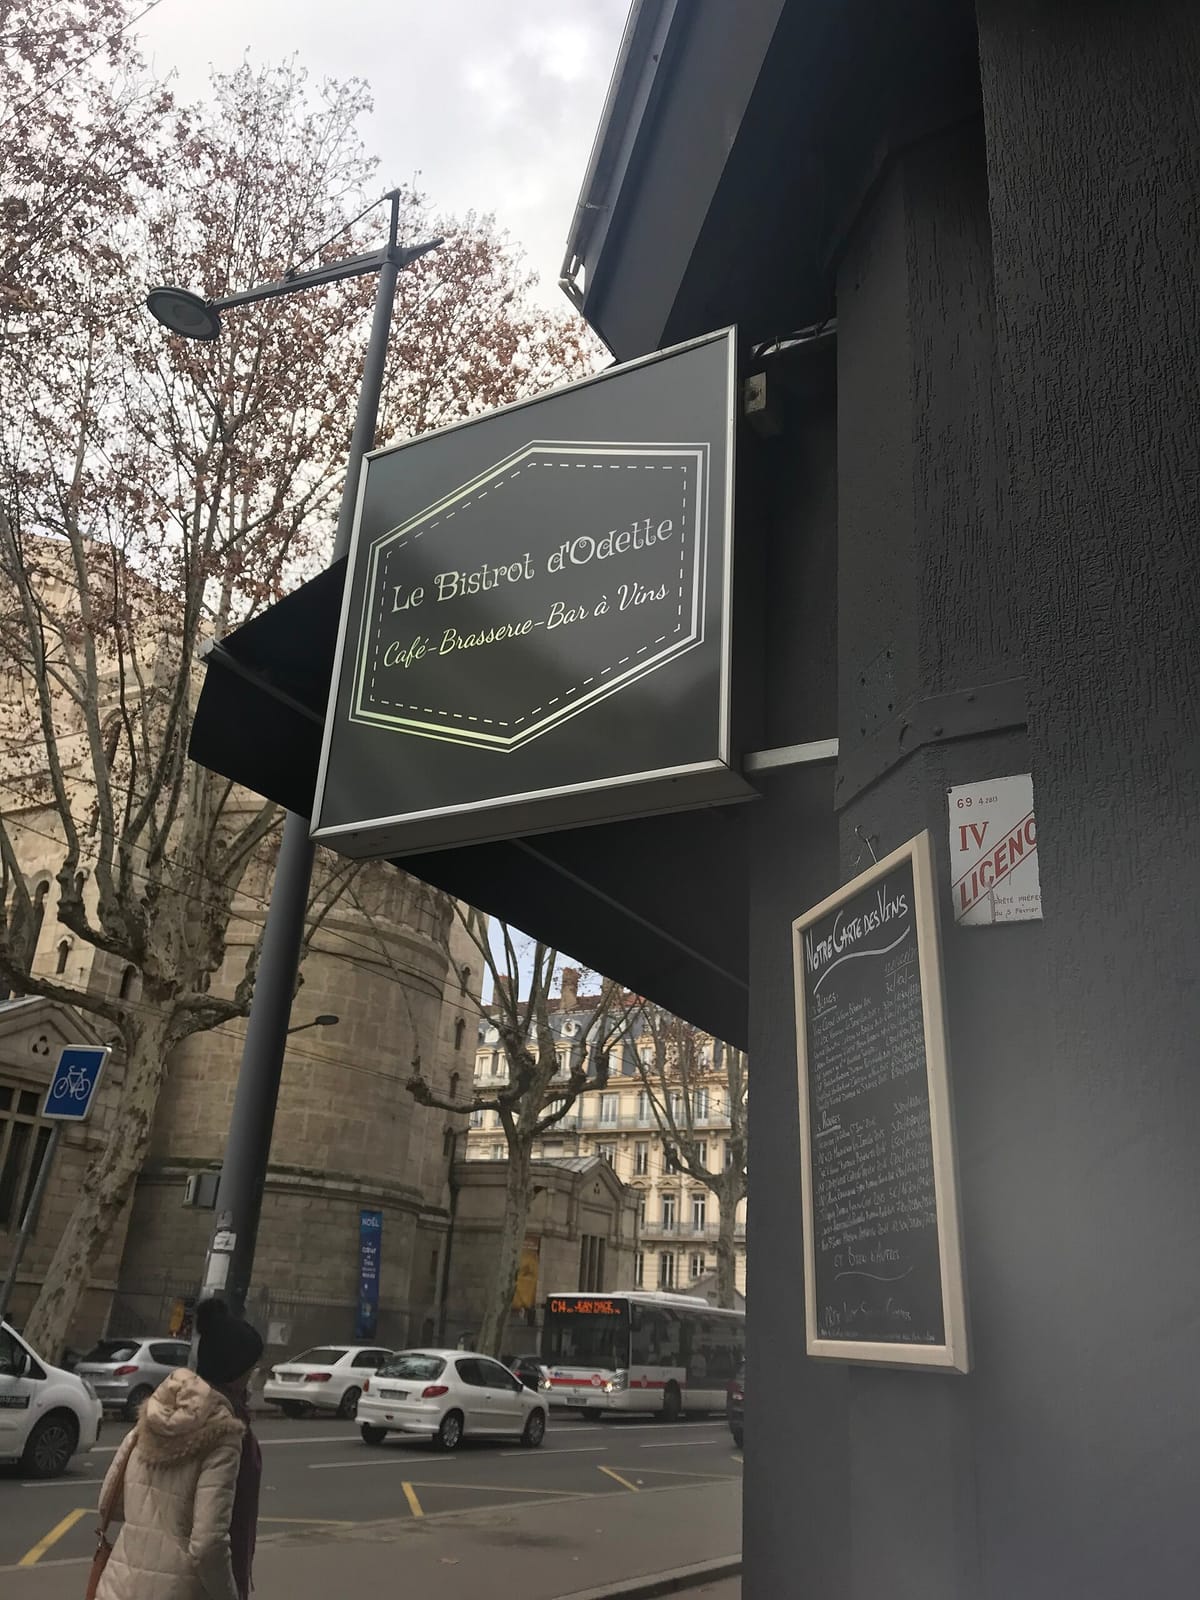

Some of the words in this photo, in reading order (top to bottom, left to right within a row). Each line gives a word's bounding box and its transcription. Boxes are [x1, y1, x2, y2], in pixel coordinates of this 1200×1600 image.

[391, 585, 424, 613] Le
[434, 553, 535, 602] Bistrot
[547, 518, 673, 573] d'Odette
[594, 595, 610, 617] à
[617, 582, 670, 611] Vins
[957, 797, 973, 808] 69
[958, 821, 989, 852] IV
